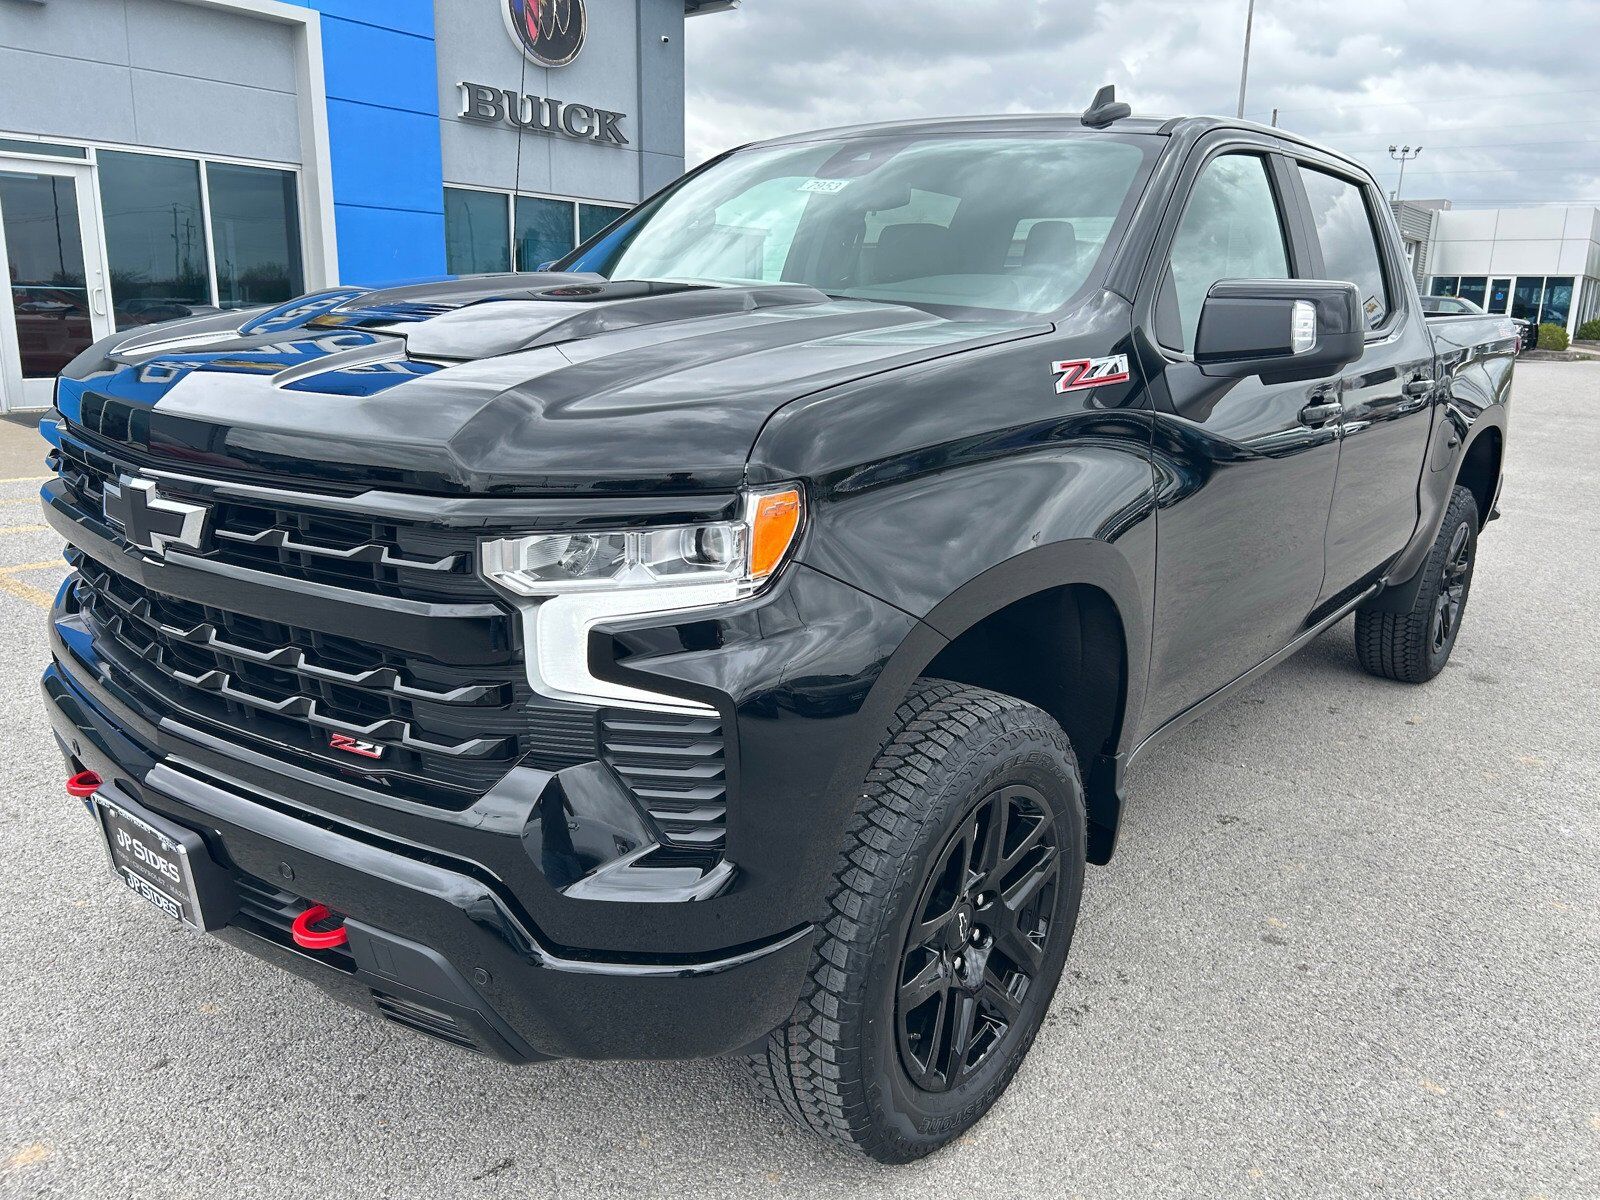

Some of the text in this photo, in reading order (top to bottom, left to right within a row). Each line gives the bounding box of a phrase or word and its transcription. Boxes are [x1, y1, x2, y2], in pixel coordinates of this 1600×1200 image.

[456, 81, 630, 145] BUICK
[1051, 353, 1130, 394] Z71
[329, 733, 385, 759] Z71
